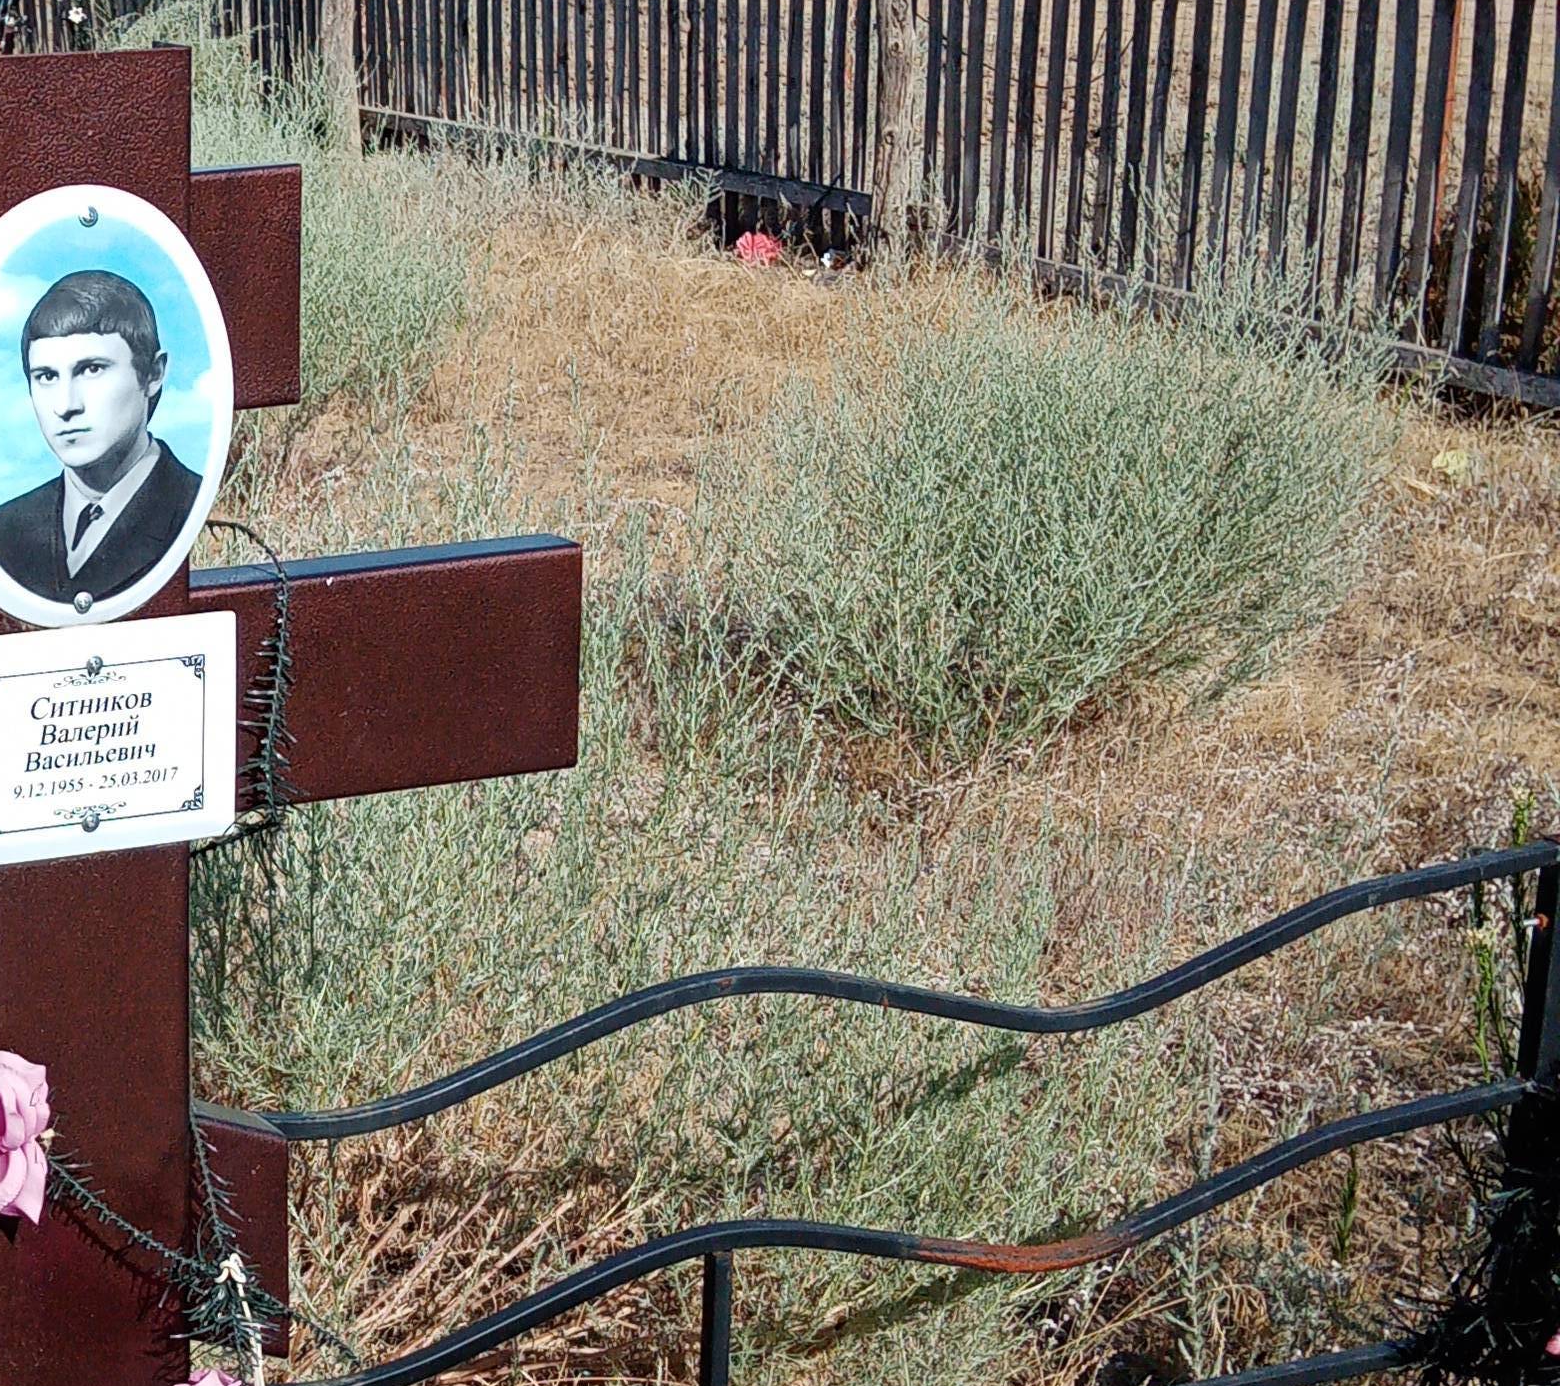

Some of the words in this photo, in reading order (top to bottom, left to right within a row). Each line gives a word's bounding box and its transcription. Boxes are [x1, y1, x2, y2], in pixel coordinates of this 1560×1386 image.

[30, 691, 153, 721] Ситников
[40, 714, 140, 746] Валерий
[24, 742, 157, 773] Васильевич
[12, 777, 84, 800] 9.12.1955
[98, 766, 179, 790] 25.03.2017
